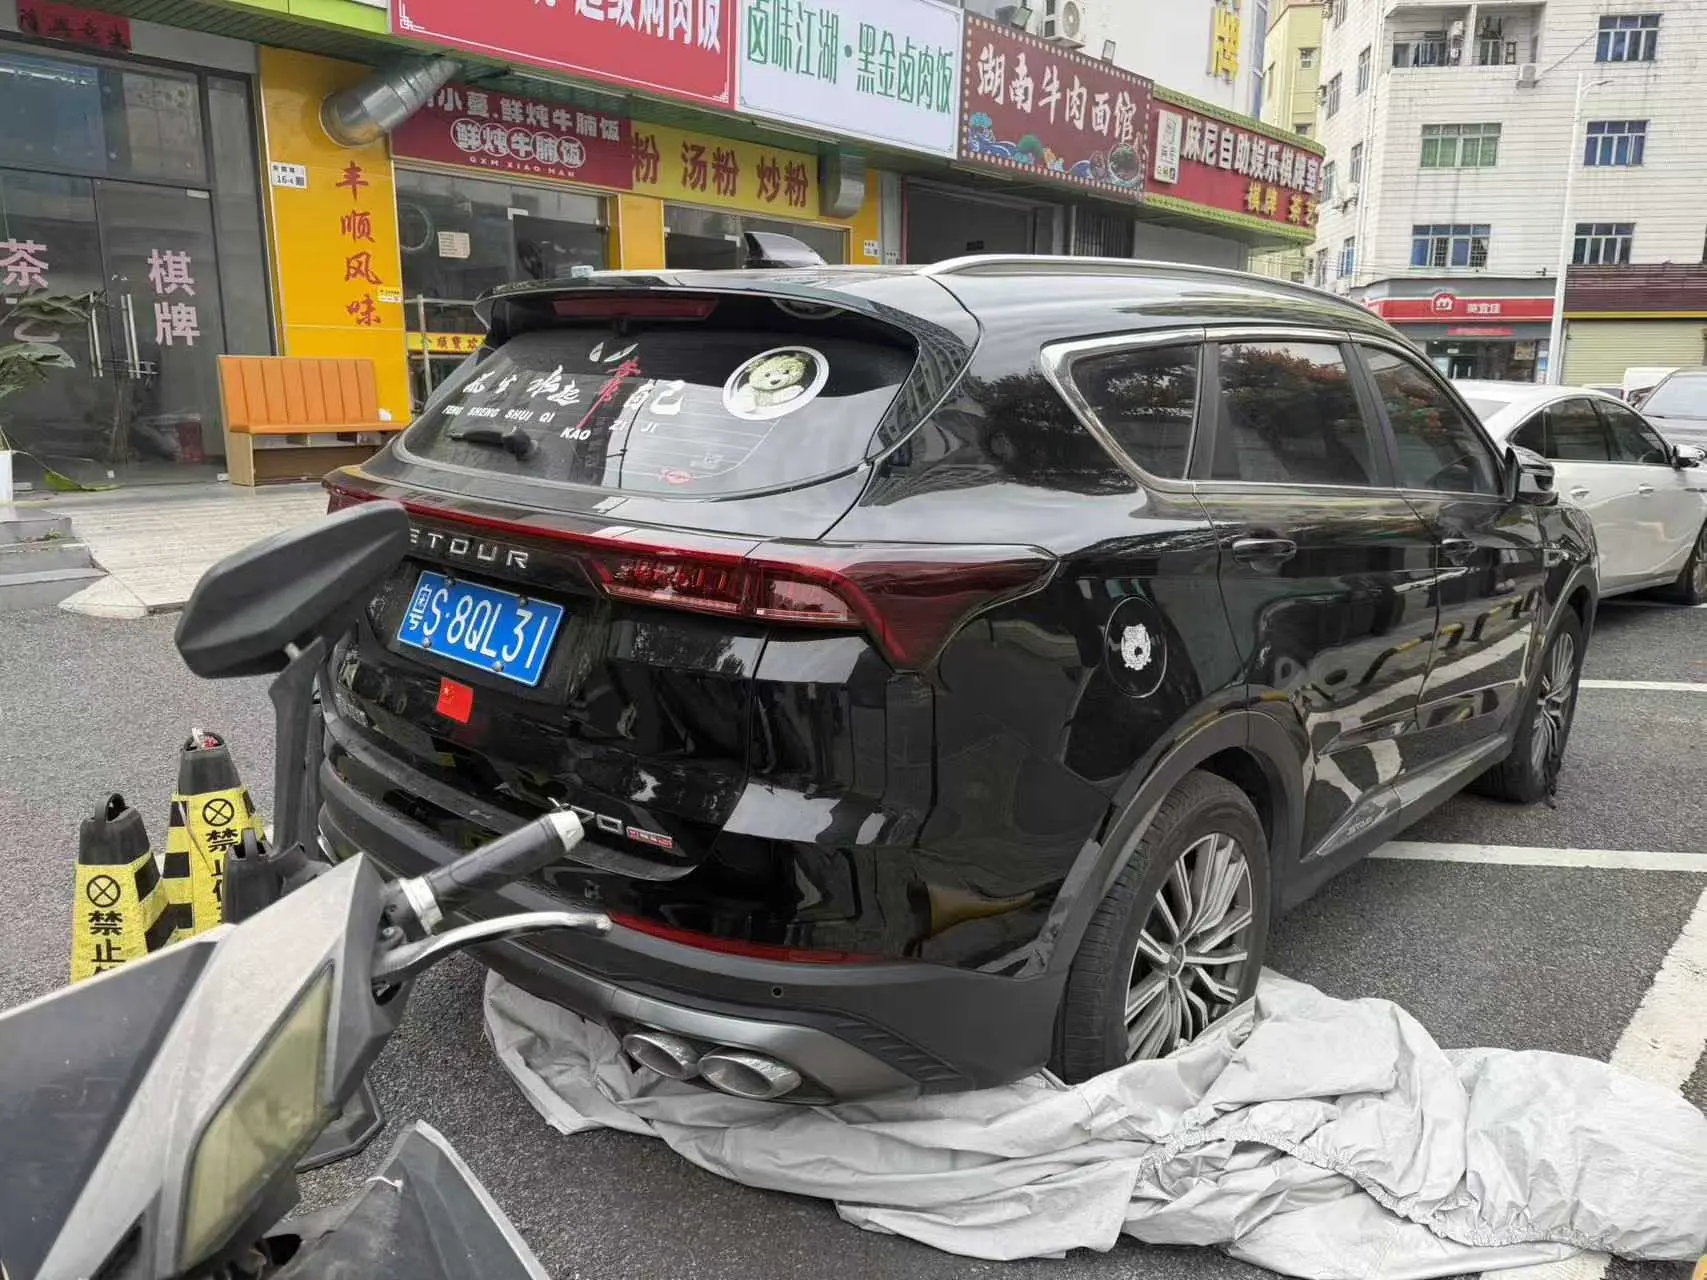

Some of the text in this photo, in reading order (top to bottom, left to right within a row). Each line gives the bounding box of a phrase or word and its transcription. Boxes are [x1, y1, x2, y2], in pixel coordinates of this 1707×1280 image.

[976, 43, 1137, 145] 湖南牛肉面馆
[456, 121, 582, 166] 鲜炖牛腩饭
[632, 131, 809, 209] 粉 汤粉 炒粉
[336, 160, 384, 327] 丰顺风味
[147, 249, 201, 346] 棋牌
[504, 408, 534, 421] SHUI
[539, 411, 556, 423] QI
[559, 426, 592, 441] KAO
[640, 421, 659, 433] JI
[408, 528, 529, 569] ETOUR
[87, 910, 127, 976] 禁止
